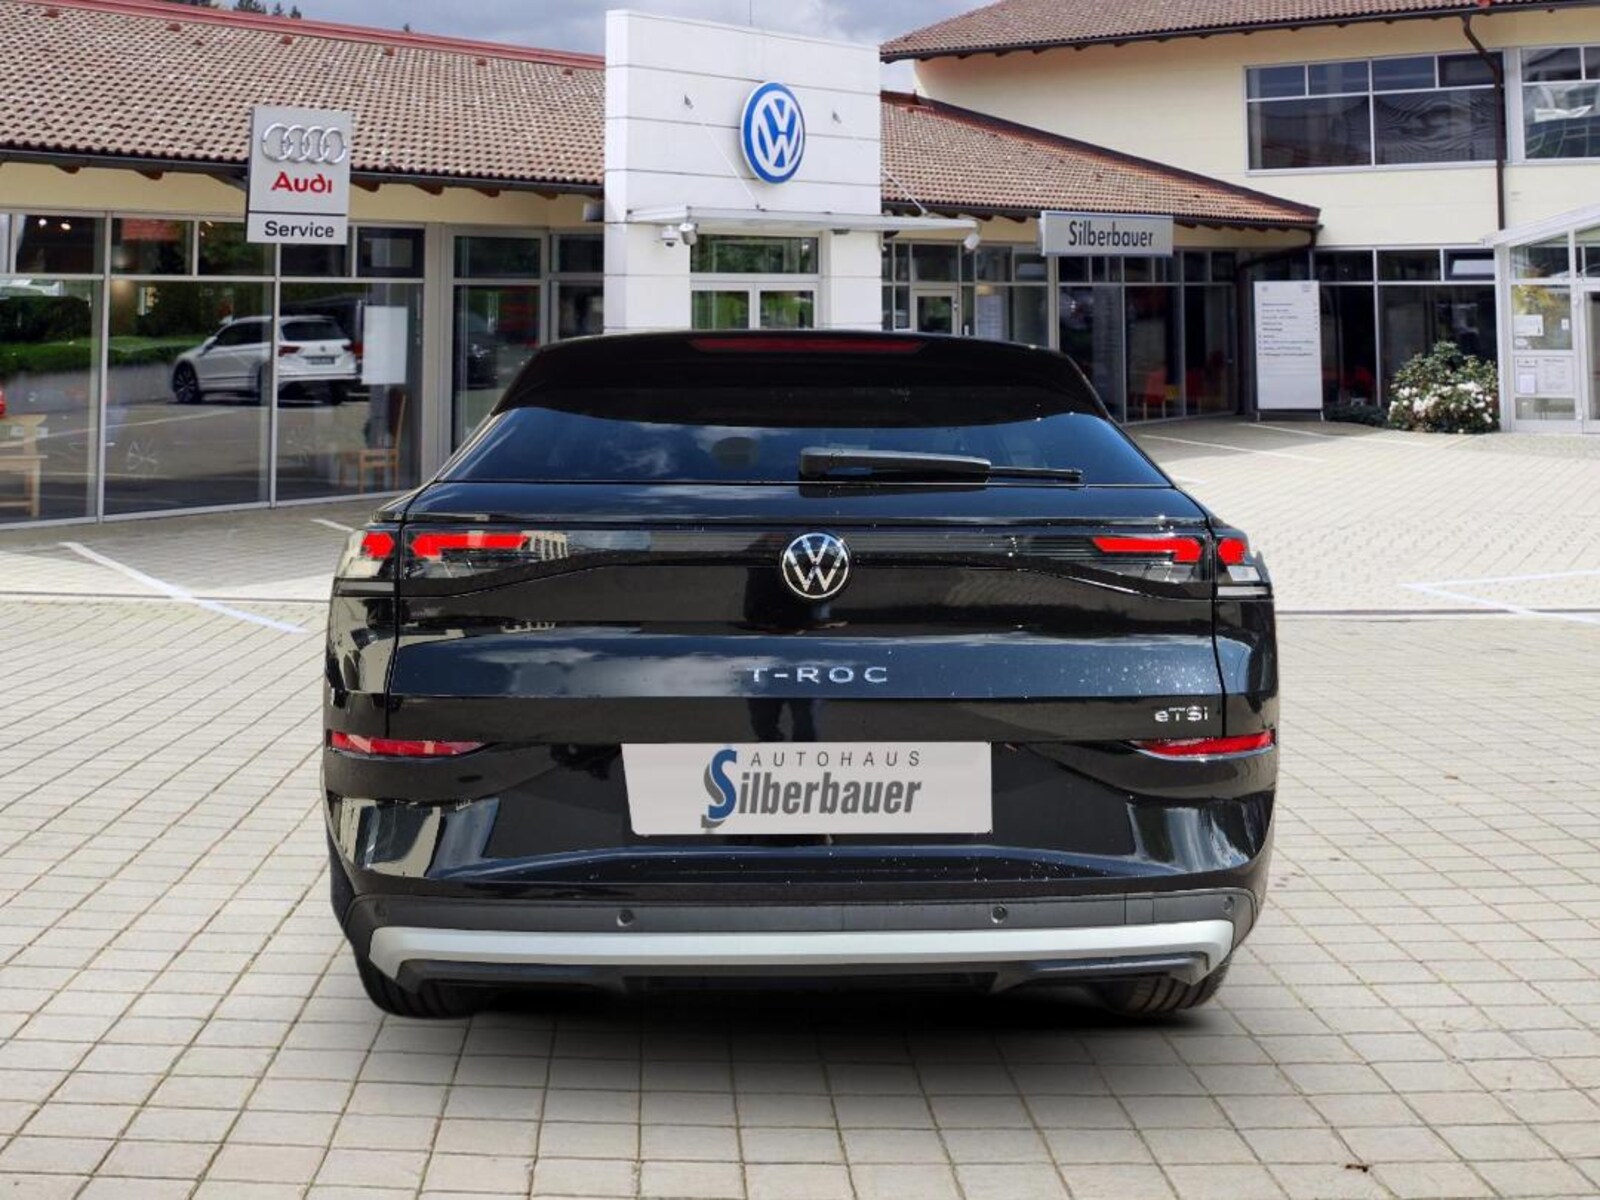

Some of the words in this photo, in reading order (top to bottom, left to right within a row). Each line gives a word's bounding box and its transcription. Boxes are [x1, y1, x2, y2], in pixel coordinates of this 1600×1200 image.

[271, 171, 333, 194] Audi
[264, 220, 334, 238] Service
[1068, 220, 1154, 247] Silberbauer
[747, 667, 888, 683] T-ROC
[1155, 706, 1208, 722] eTSi
[750, 751, 920, 767] AUTOHAUS
[701, 749, 922, 828] Silberbauer
